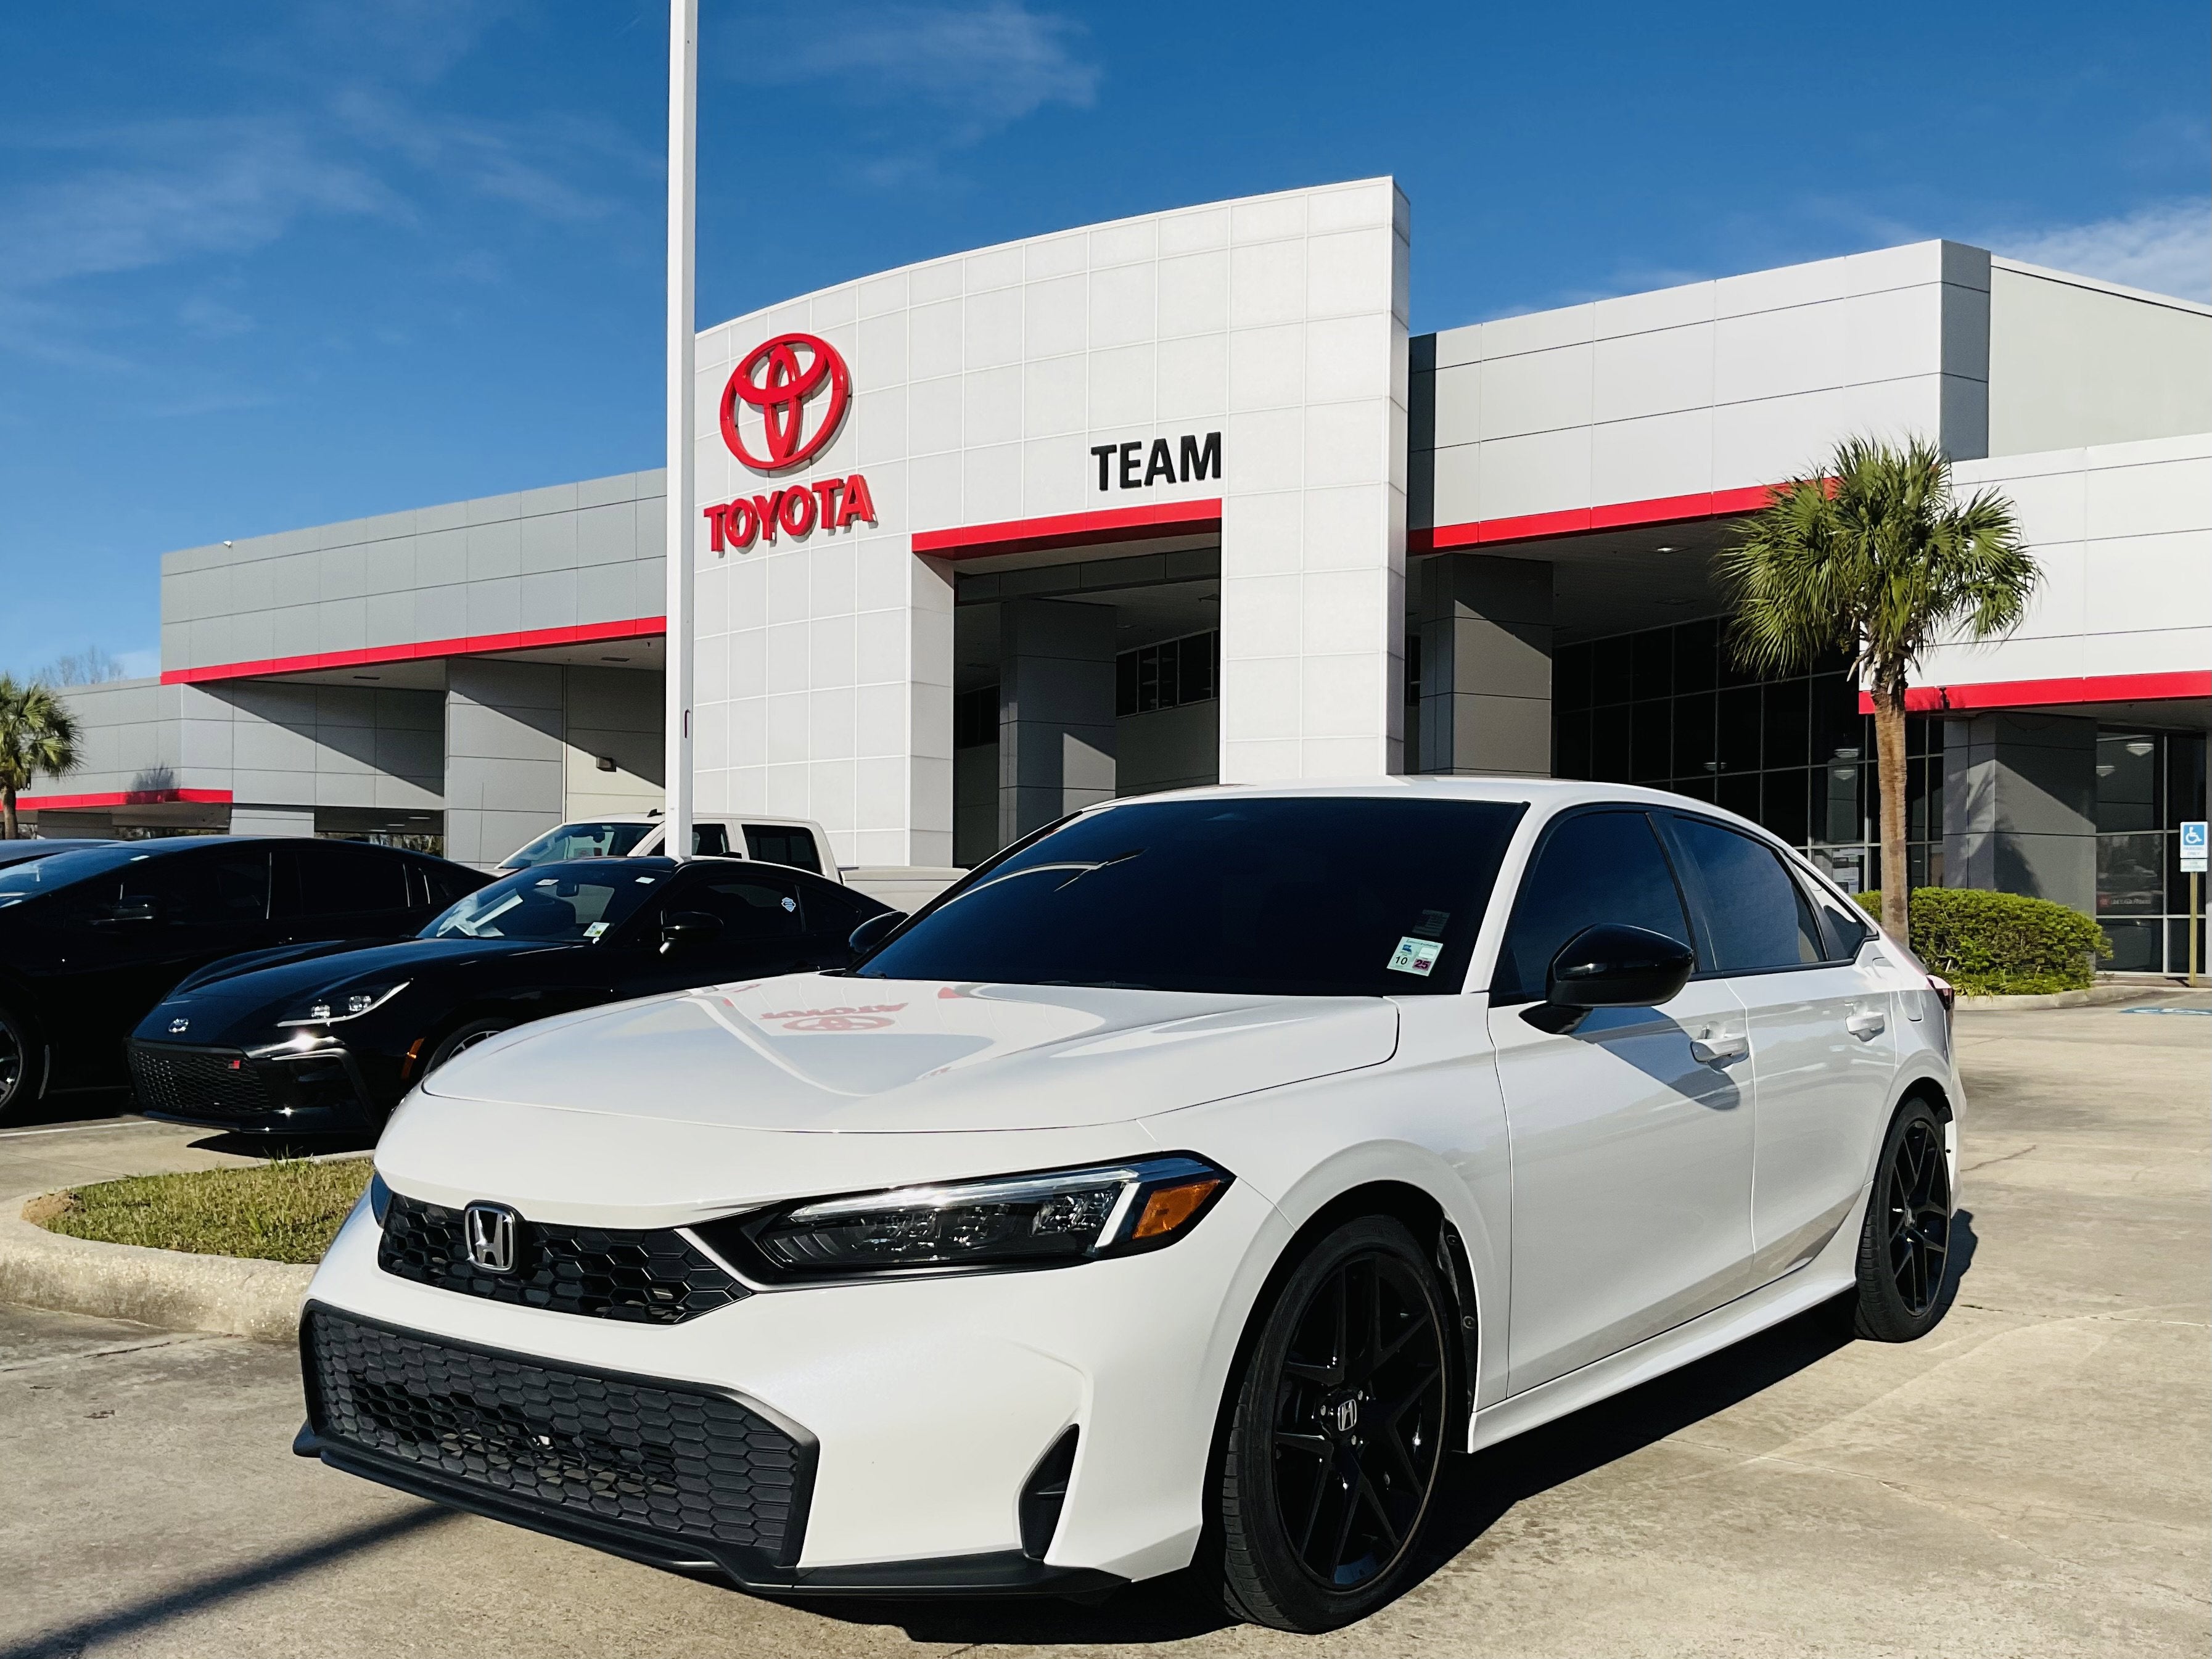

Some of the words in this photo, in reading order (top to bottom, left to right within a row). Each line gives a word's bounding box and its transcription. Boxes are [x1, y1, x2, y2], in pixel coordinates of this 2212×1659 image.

[1091, 432, 1221, 491] TEAM
[704, 474, 874, 552] TOYOTA
[1396, 956, 1408, 965] 10
[1414, 959, 1429, 969] 25
